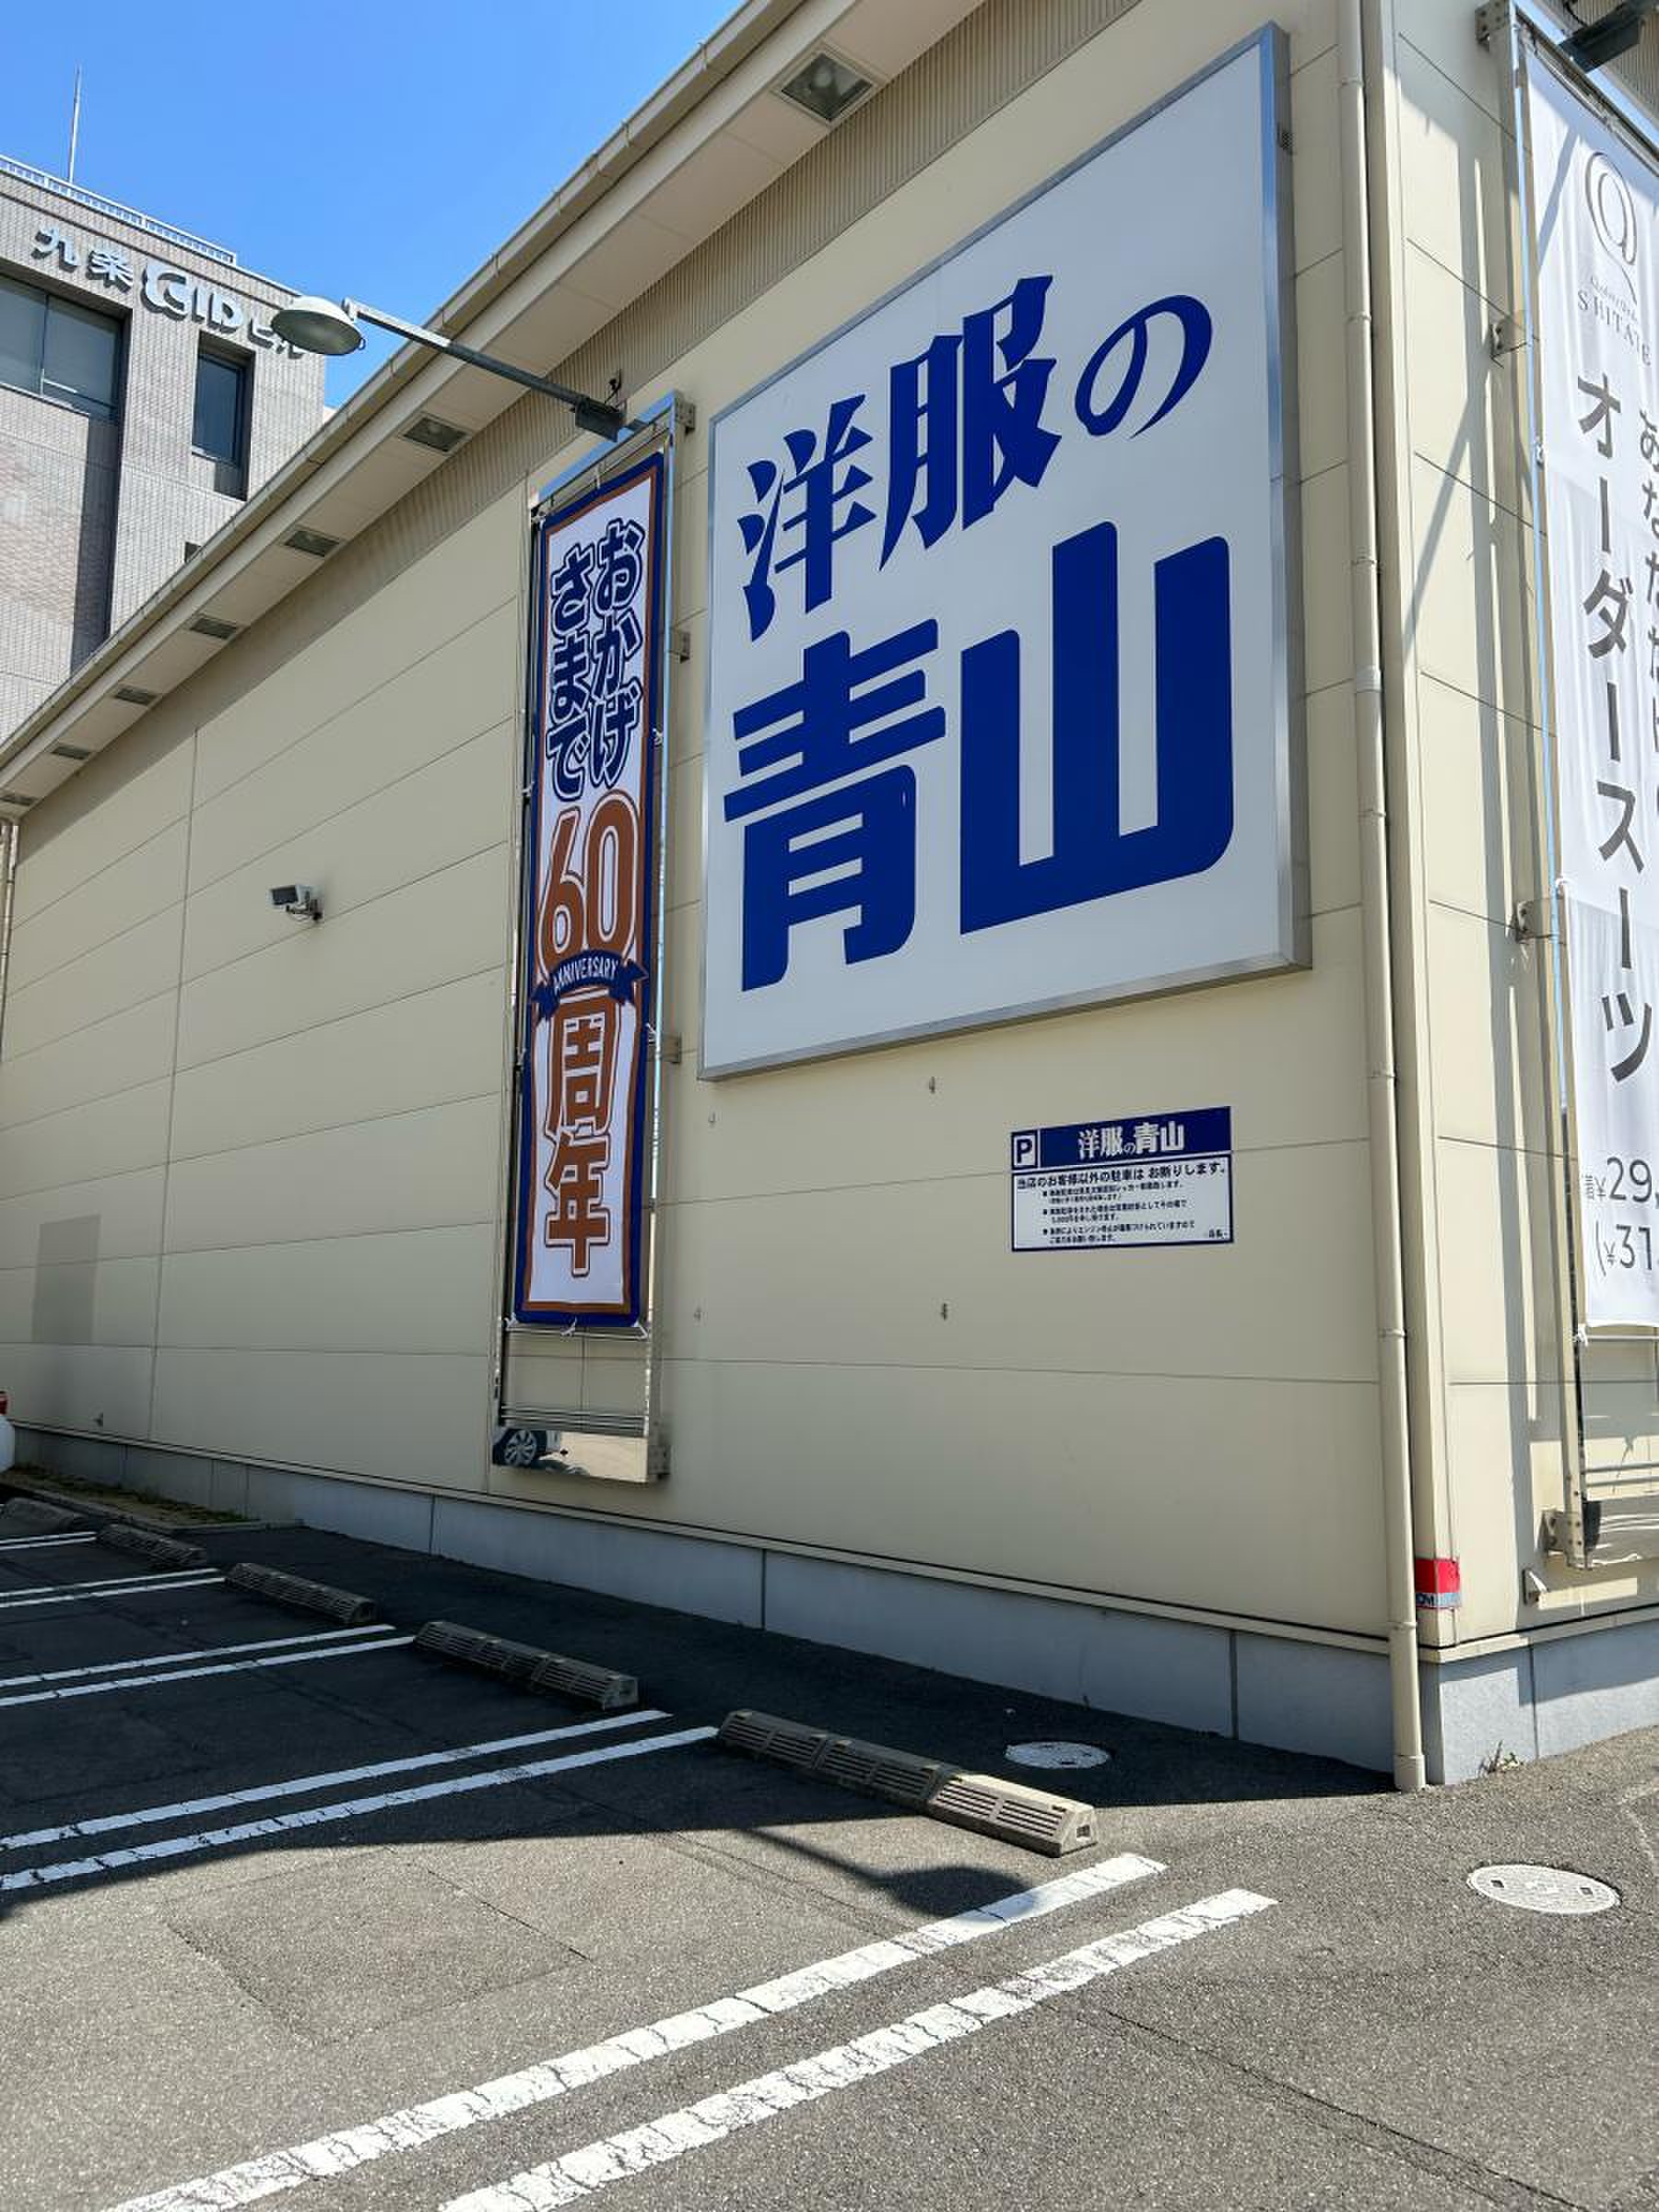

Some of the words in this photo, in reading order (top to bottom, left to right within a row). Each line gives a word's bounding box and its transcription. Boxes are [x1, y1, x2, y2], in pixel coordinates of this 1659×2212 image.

[736, 275, 1213, 642] 洋服の
[547, 542, 595, 803] さまで
[591, 518, 645, 788] おかげ
[724, 521, 1234, 993] 青山
[1578, 372, 1652, 1082] オーダースーツ
[538, 790, 640, 972] 60
[553, 956, 618, 995] ANNIVERSARY
[545, 988, 620, 1277] 周年
[1017, 1138, 1032, 1163] P
[1077, 1121, 1185, 1160] 洋服の青山
